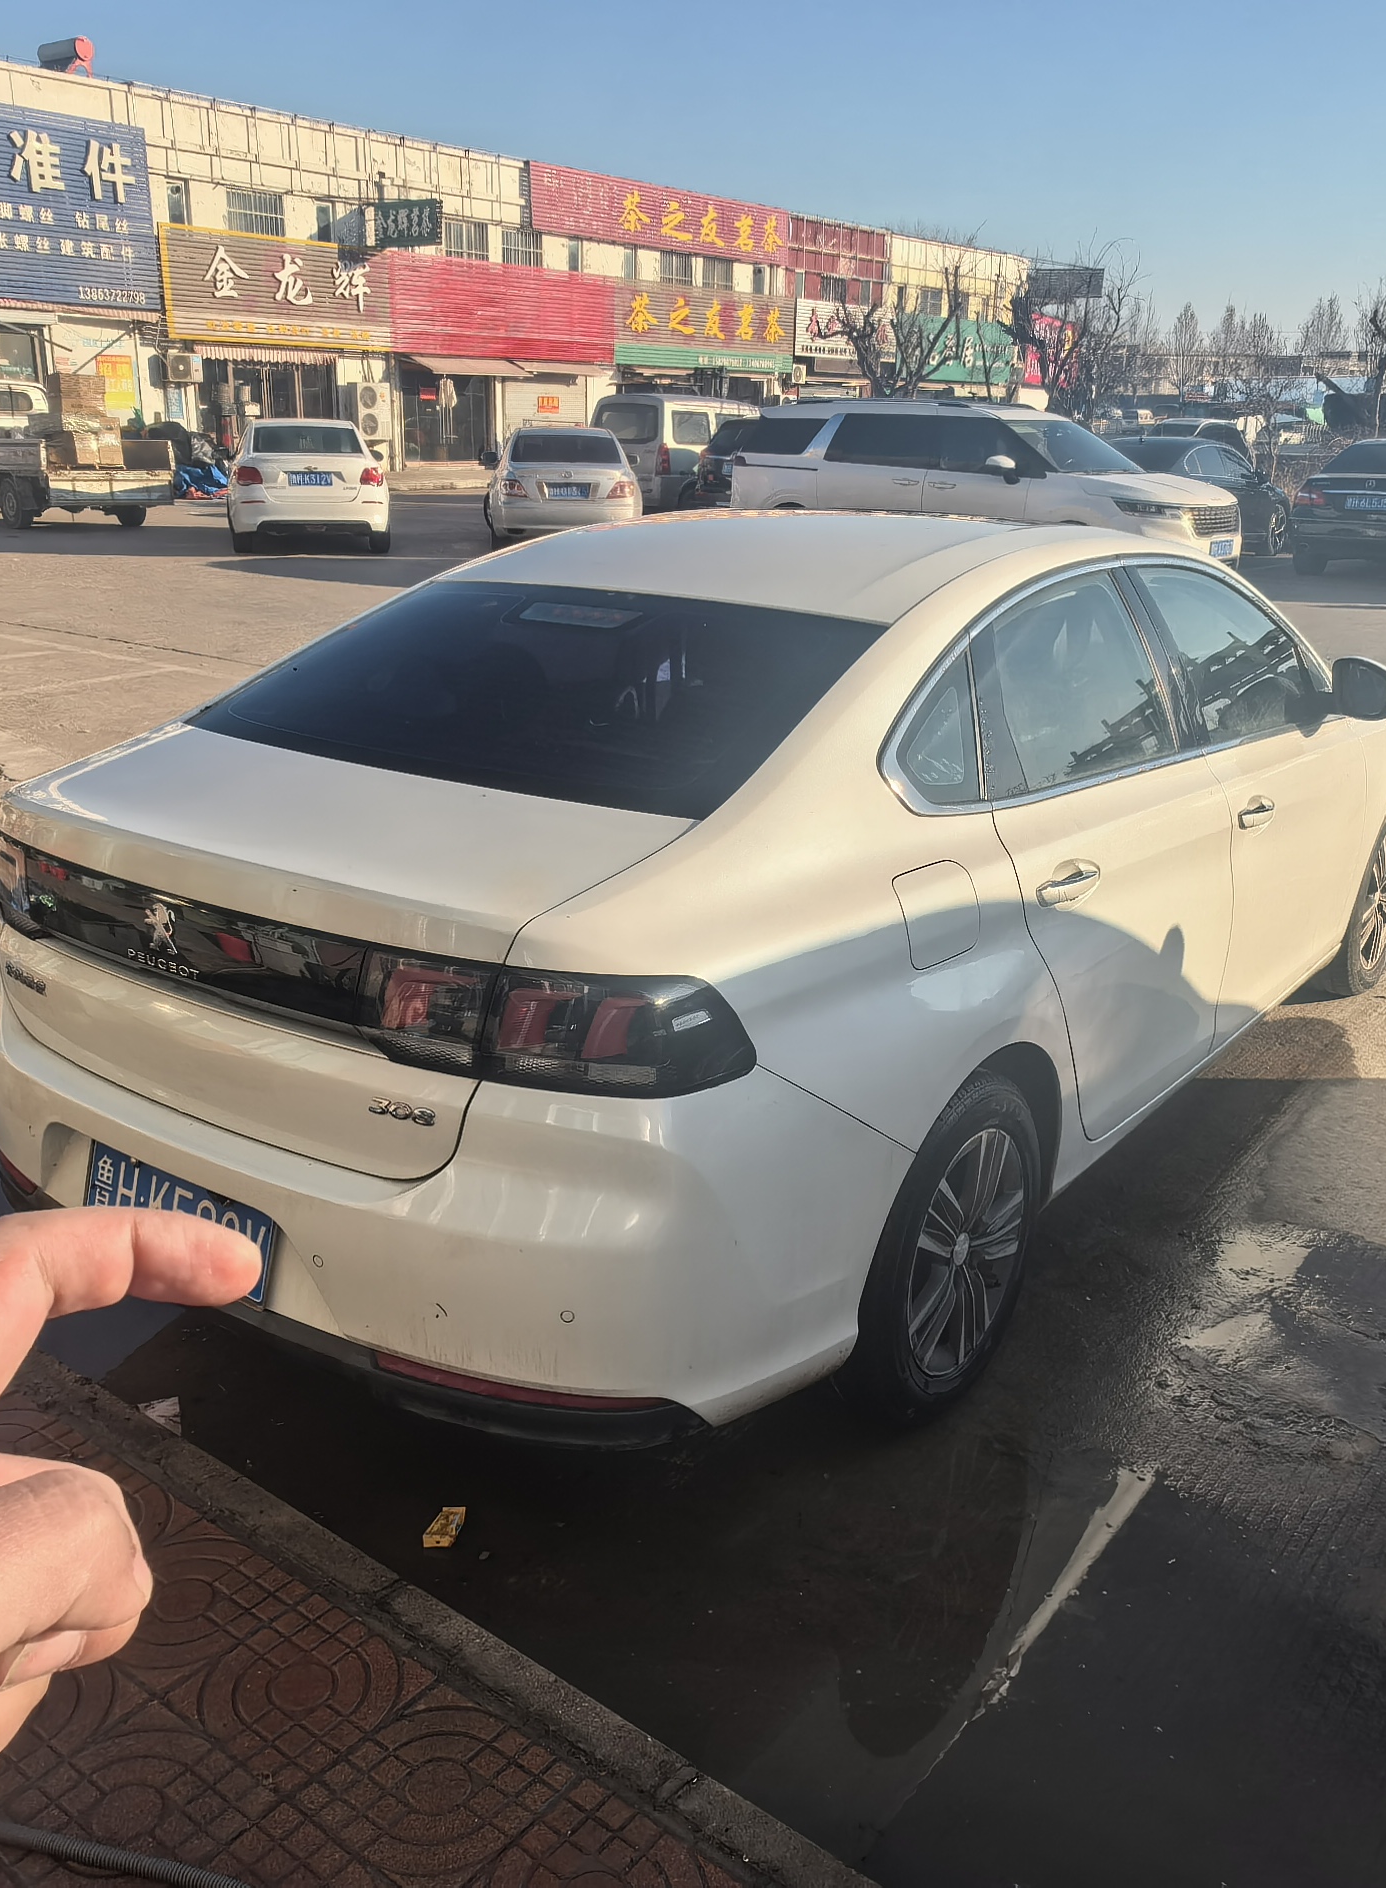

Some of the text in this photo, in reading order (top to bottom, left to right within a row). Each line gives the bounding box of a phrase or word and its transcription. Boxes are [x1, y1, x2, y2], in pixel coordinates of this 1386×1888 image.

[74, 211, 129, 234] 钻尾丝
[202, 245, 371, 313] 金龙辉
[127, 948, 199, 979] PEUGEOT
